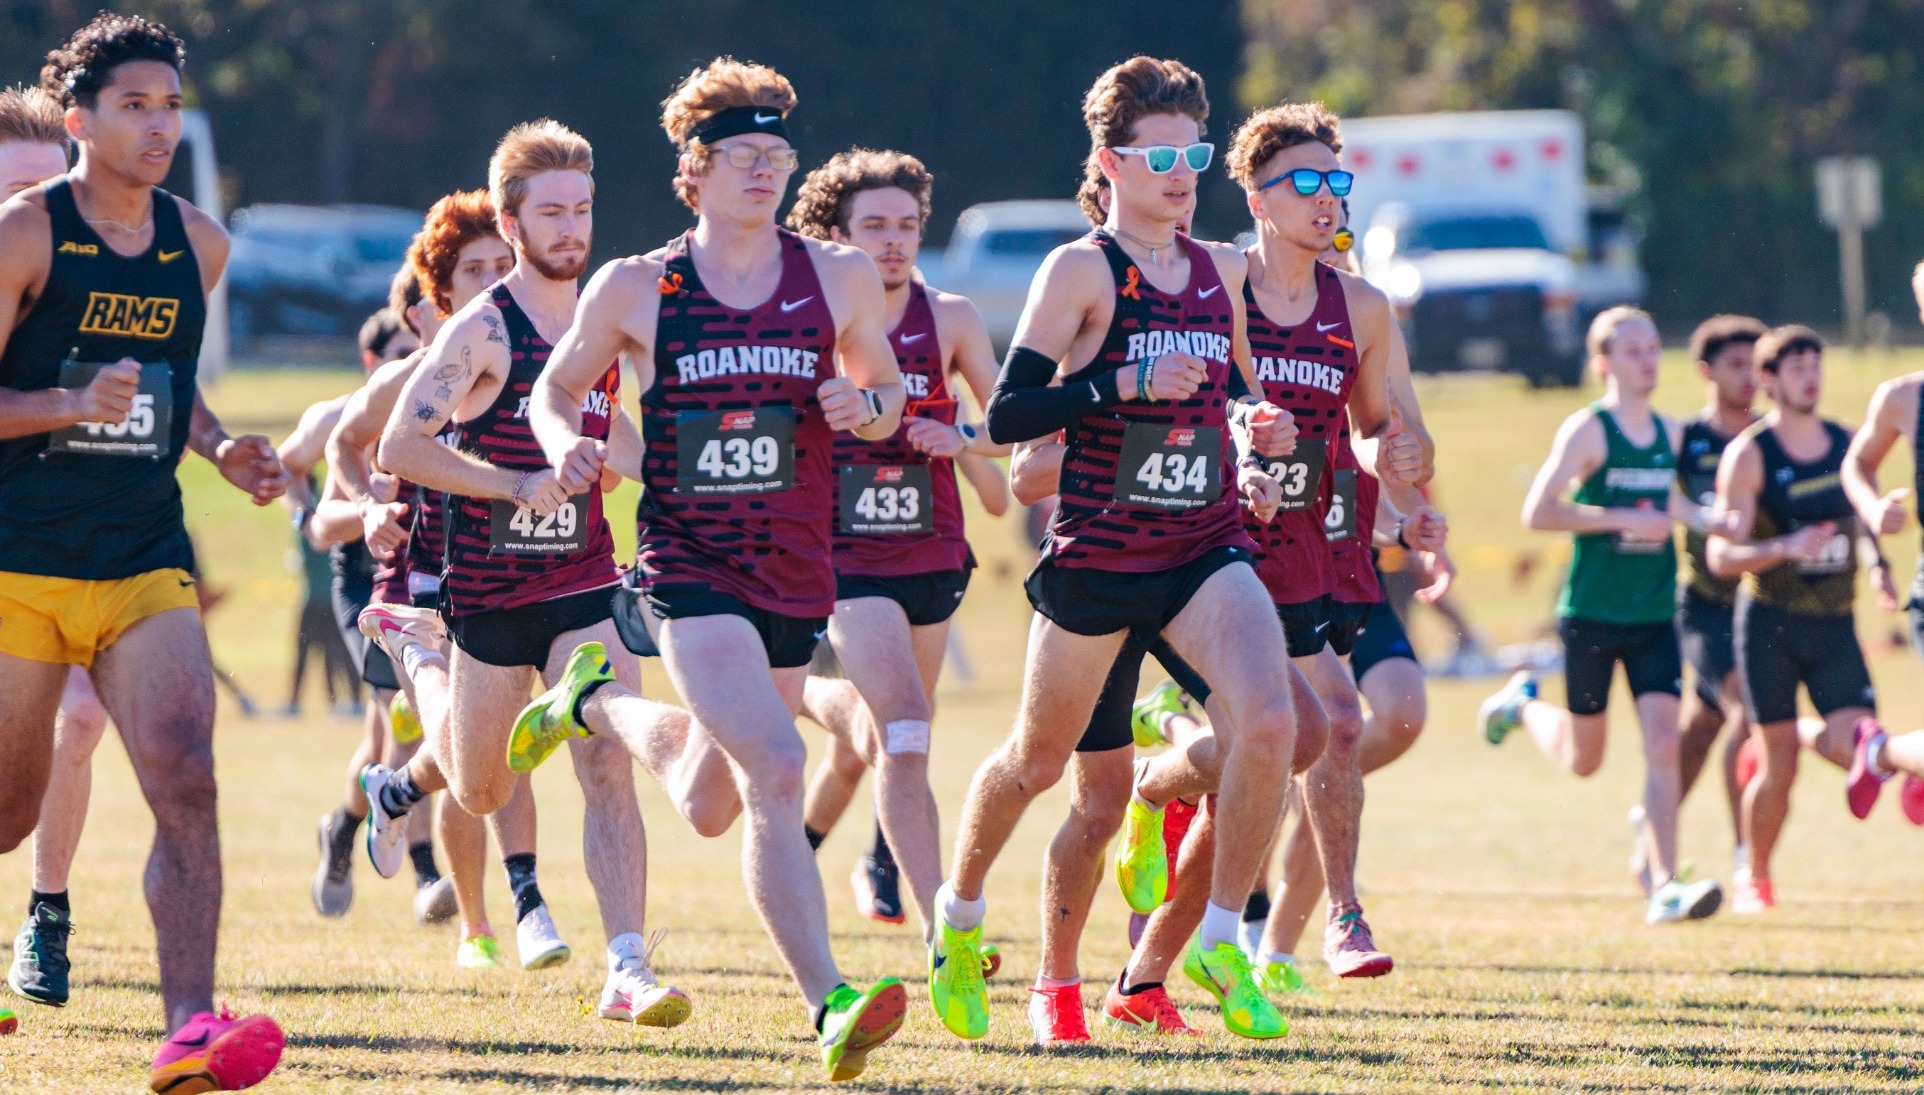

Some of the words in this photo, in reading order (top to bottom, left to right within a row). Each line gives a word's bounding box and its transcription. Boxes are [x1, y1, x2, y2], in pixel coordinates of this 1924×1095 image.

[79, 291, 180, 339] RAMS
[1126, 330, 1230, 365] ROANOKE
[676, 346, 818, 385] ROANOKE
[1252, 357, 1344, 395] ANOKE
[1164, 429, 1195, 445] SNAP
[697, 436, 779, 478] 439
[1137, 453, 1207, 493] 434
[694, 480, 782, 492] www.snaptiming.com
[1267, 462, 1308, 496] 23
[855, 486, 919, 520] 433
[1129, 494, 1207, 507] www.snaptiming.com
[509, 502, 577, 538] 429
[505, 541, 578, 551] www.snaptiming.com
